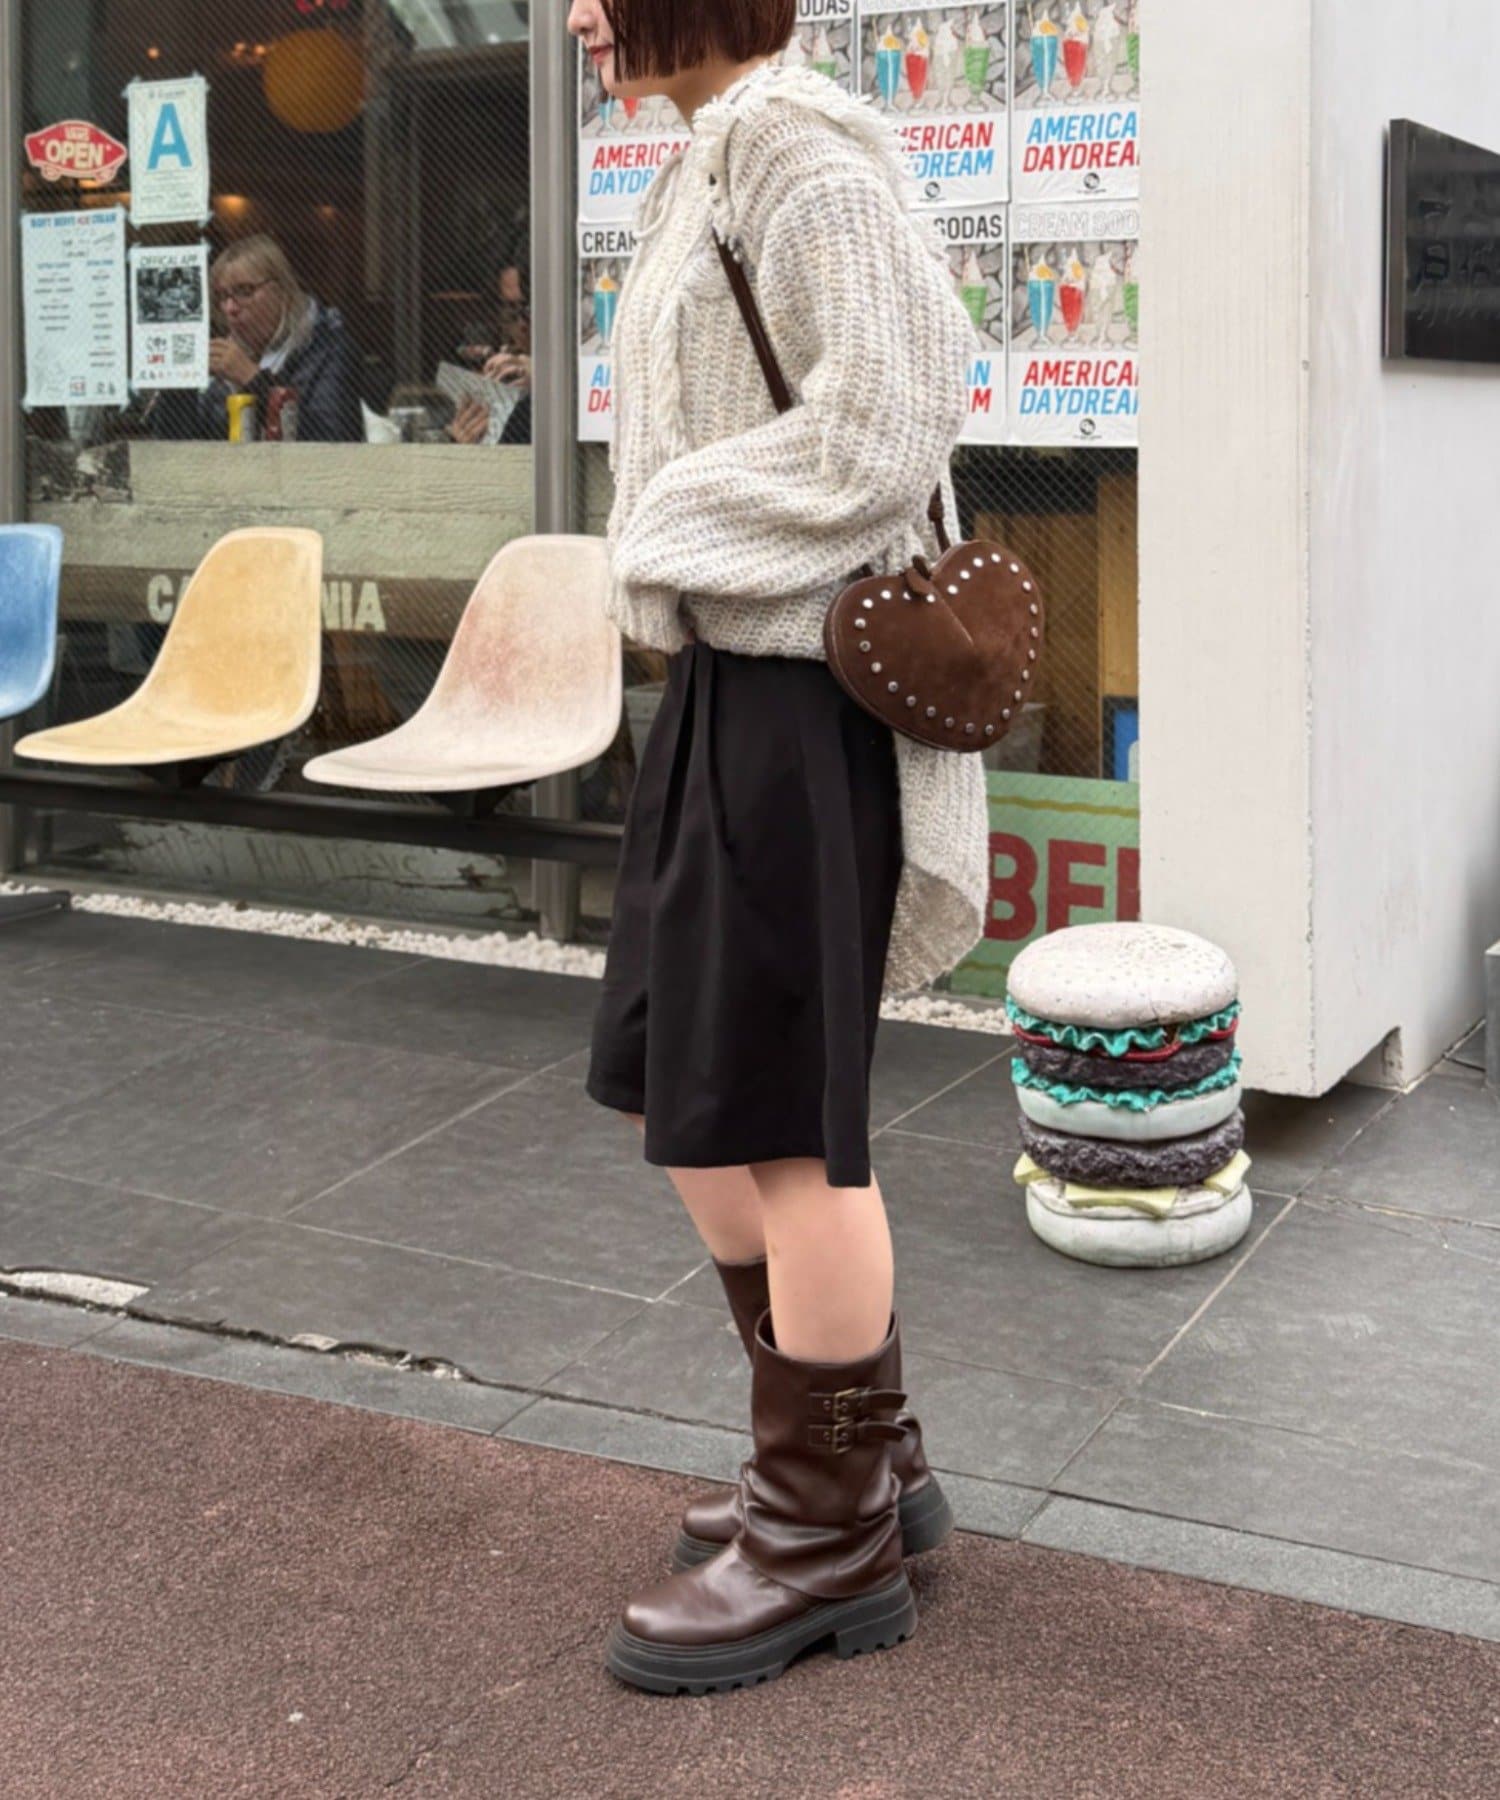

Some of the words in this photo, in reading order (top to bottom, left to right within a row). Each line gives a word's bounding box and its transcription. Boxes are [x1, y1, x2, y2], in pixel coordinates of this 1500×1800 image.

[147, 102, 193, 171] A
[45, 138, 104, 170] OPEN
[909, 149, 995, 178] DREAM
[1023, 140, 1139, 173] DAYDREA
[1023, 359, 1139, 387] AMERICA
